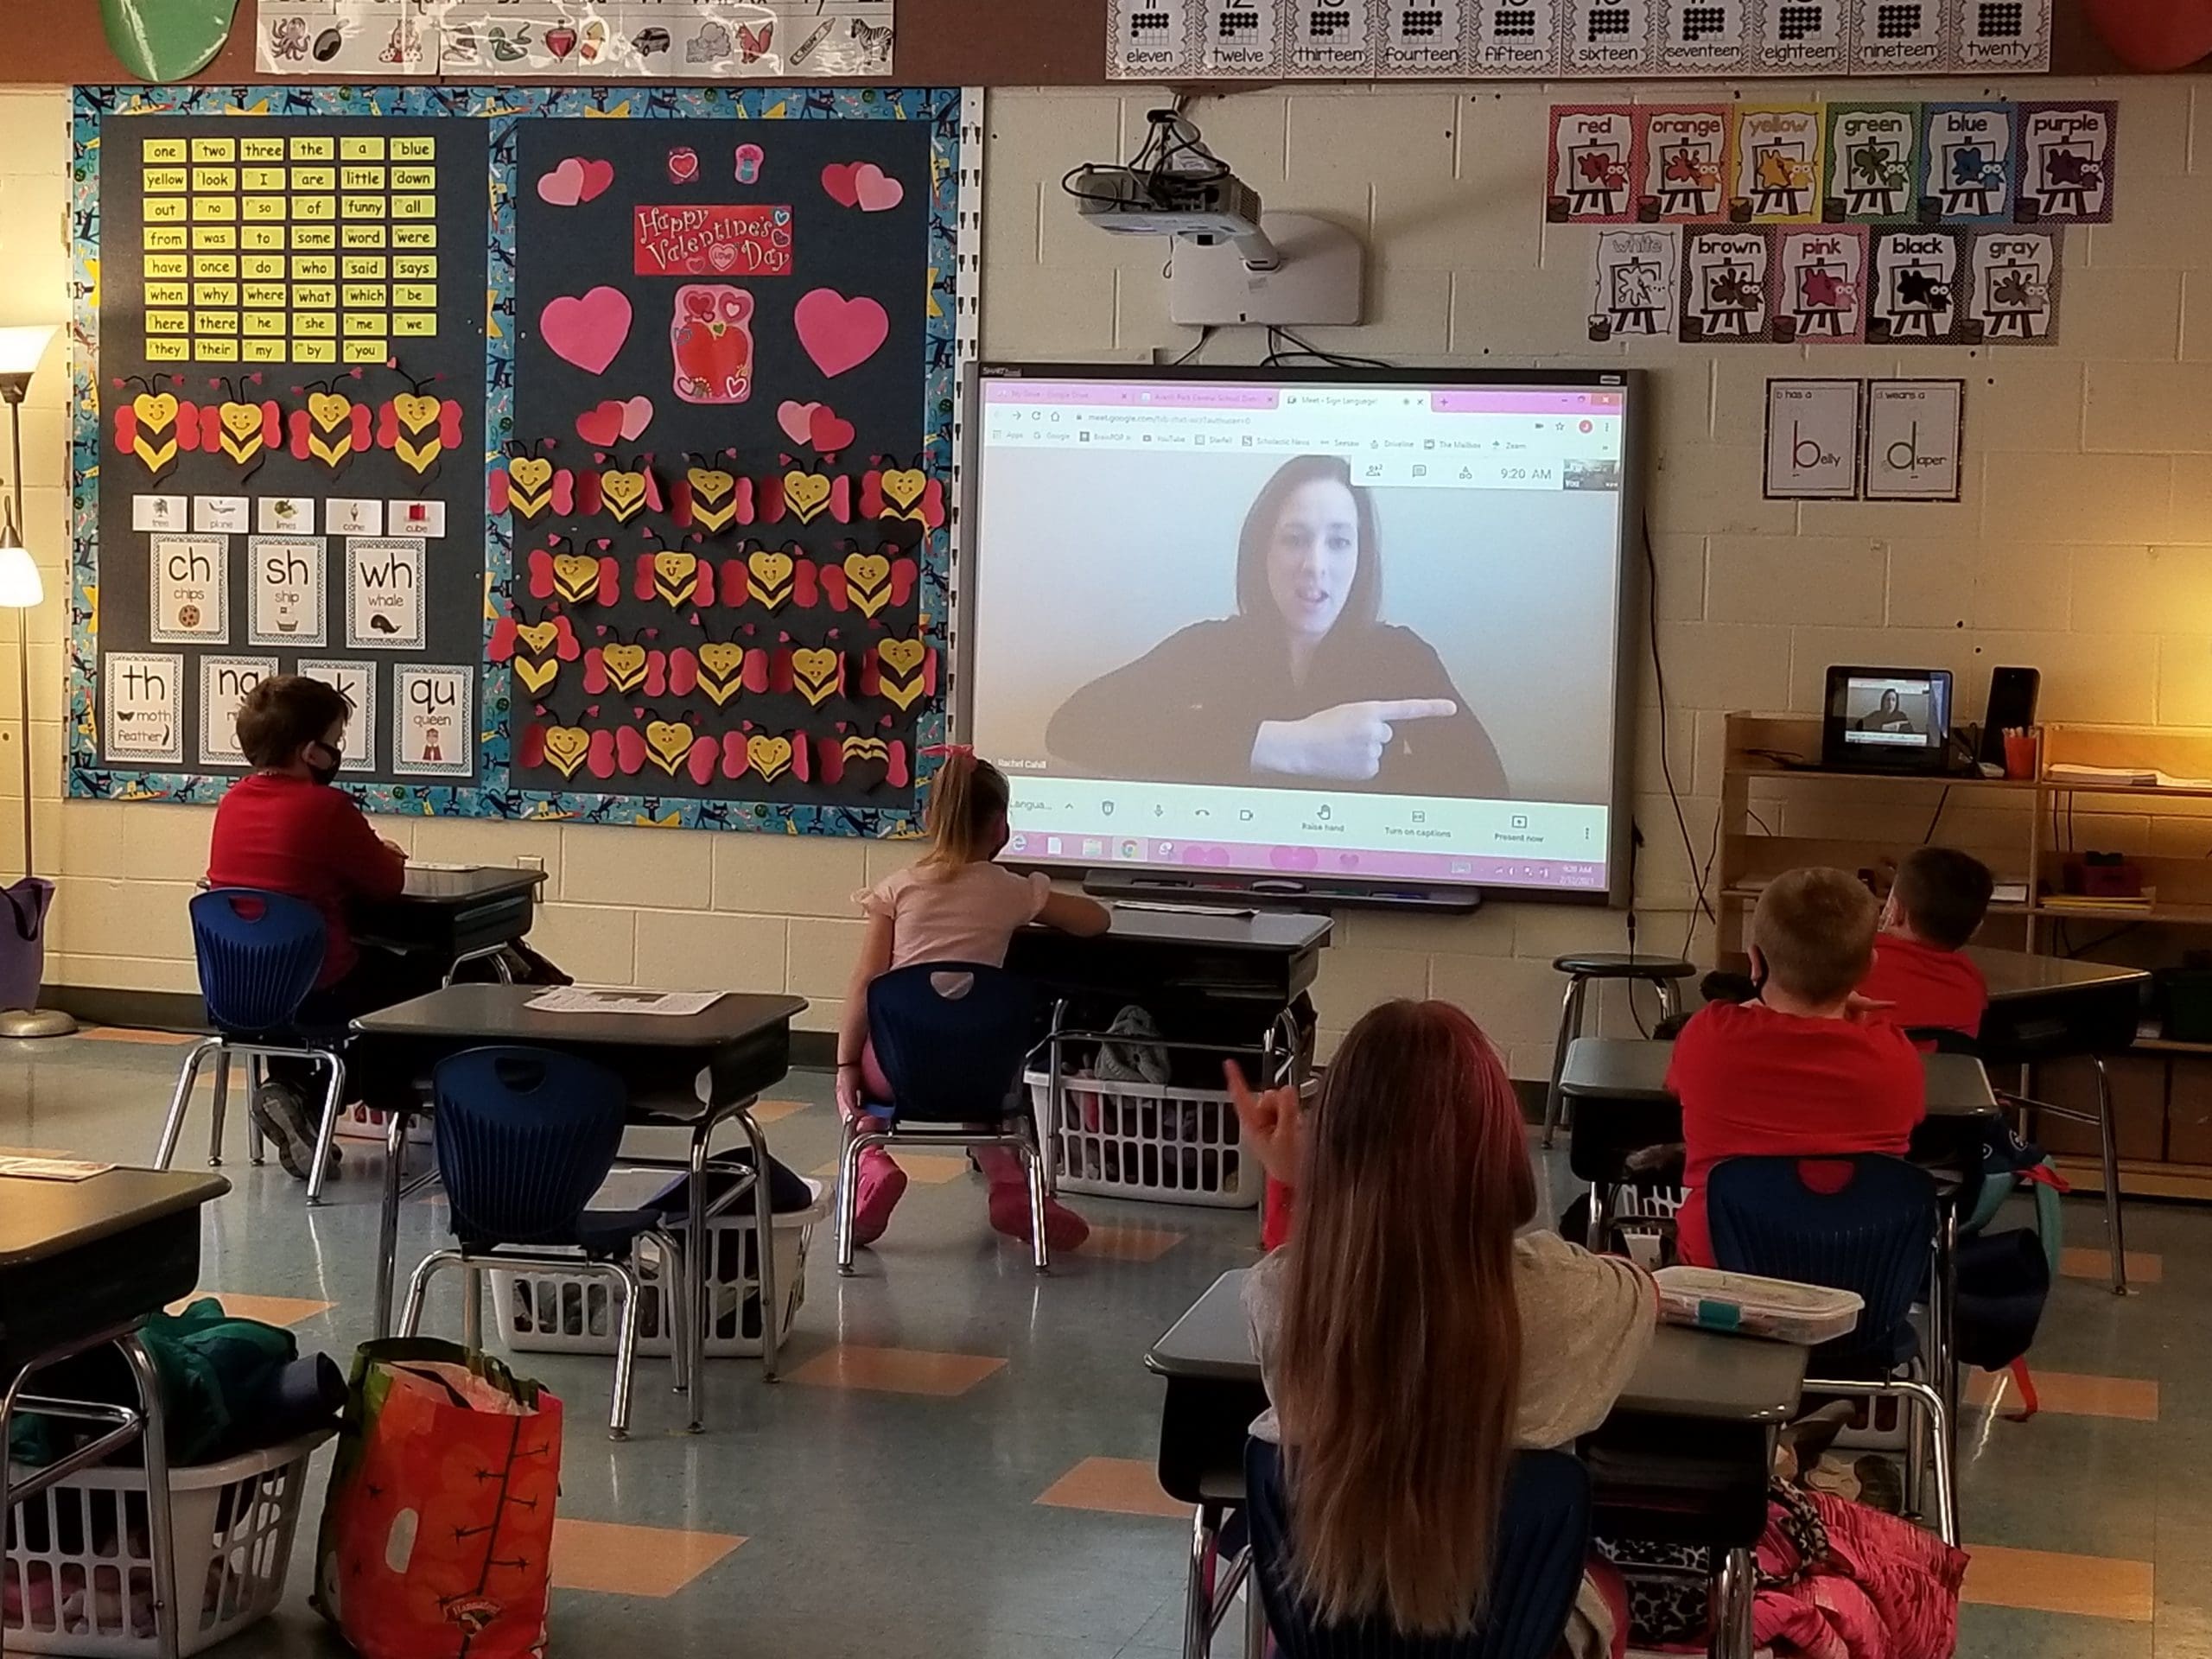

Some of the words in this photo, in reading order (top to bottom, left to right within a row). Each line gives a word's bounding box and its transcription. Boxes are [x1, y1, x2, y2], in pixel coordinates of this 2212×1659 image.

[1127, 49, 1173, 62] eleven
[1213, 48, 1263, 61] twelve
[1298, 47, 1363, 61] thirteen
[1385, 46, 1459, 60] fourteen
[1485, 46, 1543, 60] fifteen
[1579, 46, 1638, 60] sixteen
[1668, 44, 1740, 57] seventeen
[1764, 43, 1837, 62] eighteen
[1865, 41, 1936, 58] nineteen
[1967, 41, 2032, 59] twenty
[1578, 117, 1612, 134] red
[1652, 118, 1720, 137] orange
[1748, 115, 1808, 137] yellow
[1844, 117, 1902, 136] green
[1947, 115, 1987, 131] blue
[2034, 114, 2099, 136] purple
[155, 147, 176, 157] one
[203, 145, 226, 156] two
[245, 143, 282, 156] three
[302, 143, 323, 156] the
[359, 144, 366, 154] a
[402, 142, 429, 155] blue
[147, 173, 183, 188] yellow
[202, 172, 228, 186] look
[260, 174, 268, 185] I
[302, 175, 324, 185] are
[346, 171, 379, 185] little
[397, 171, 430, 185] down
[155, 204, 175, 215] out
[208, 205, 220, 213] no
[259, 204, 271, 213] so
[308, 201, 321, 214] of
[348, 200, 382, 215] funny
[405, 200, 420, 213] all
[638, 207, 709, 244] Happy
[150, 232, 181, 245] from
[204, 234, 226, 244] was
[257, 232, 270, 244] to
[298, 233, 330, 244] some
[347, 231, 379, 244] word
[397, 233, 430, 244] were
[645, 217, 772, 270] Valentine's
[1612, 235, 1662, 253] white
[1698, 238, 1761, 254] brown
[1802, 238, 1841, 259] pink
[1892, 237, 1943, 255] black
[1989, 241, 2040, 258] gray
[741, 239, 790, 271] Day
[153, 259, 182, 273] have
[200, 263, 230, 273] once
[256, 260, 271, 273] do
[302, 261, 327, 274] who
[351, 261, 378, 274] said
[400, 263, 429, 277] says
[150, 289, 183, 301] when
[203, 288, 228, 302] why
[248, 288, 284, 301] where
[298, 289, 331, 302] what
[351, 289, 384, 302] which
[408, 289, 422, 301] be
[155, 315, 185, 329] here
[200, 315, 236, 329] there
[258, 317, 271, 328] he
[306, 317, 325, 329] she
[356, 321, 373, 329] me
[407, 321, 423, 329] we
[155, 343, 181, 358] they
[202, 342, 230, 355] their
[256, 346, 272, 358] my
[308, 344, 321, 359] by
[355, 346, 375, 359] you
[1785, 390, 1802, 398] has
[1500, 469, 1526, 479] 9:20
[1532, 469, 1552, 480] AM
[210, 520, 233, 529] plane
[343, 523, 365, 531] cone
[405, 524, 428, 533] cube
[168, 546, 211, 582] ch
[266, 549, 308, 585] sh
[359, 552, 412, 588] wh
[173, 588, 206, 602] chips
[275, 591, 300, 606] ship
[368, 594, 404, 607] whale
[122, 664, 165, 701] th
[219, 668, 259, 702] ng
[410, 678, 455, 714] qu
[137, 710, 171, 721] moth
[413, 715, 451, 728] queen
[118, 729, 162, 742] feather
[1302, 822, 1323, 830] Raise
[1325, 823, 1344, 832] hand
[1385, 827, 1402, 836] Turn
[1416, 829, 1452, 839] captions
[1495, 833, 1524, 842] Present
